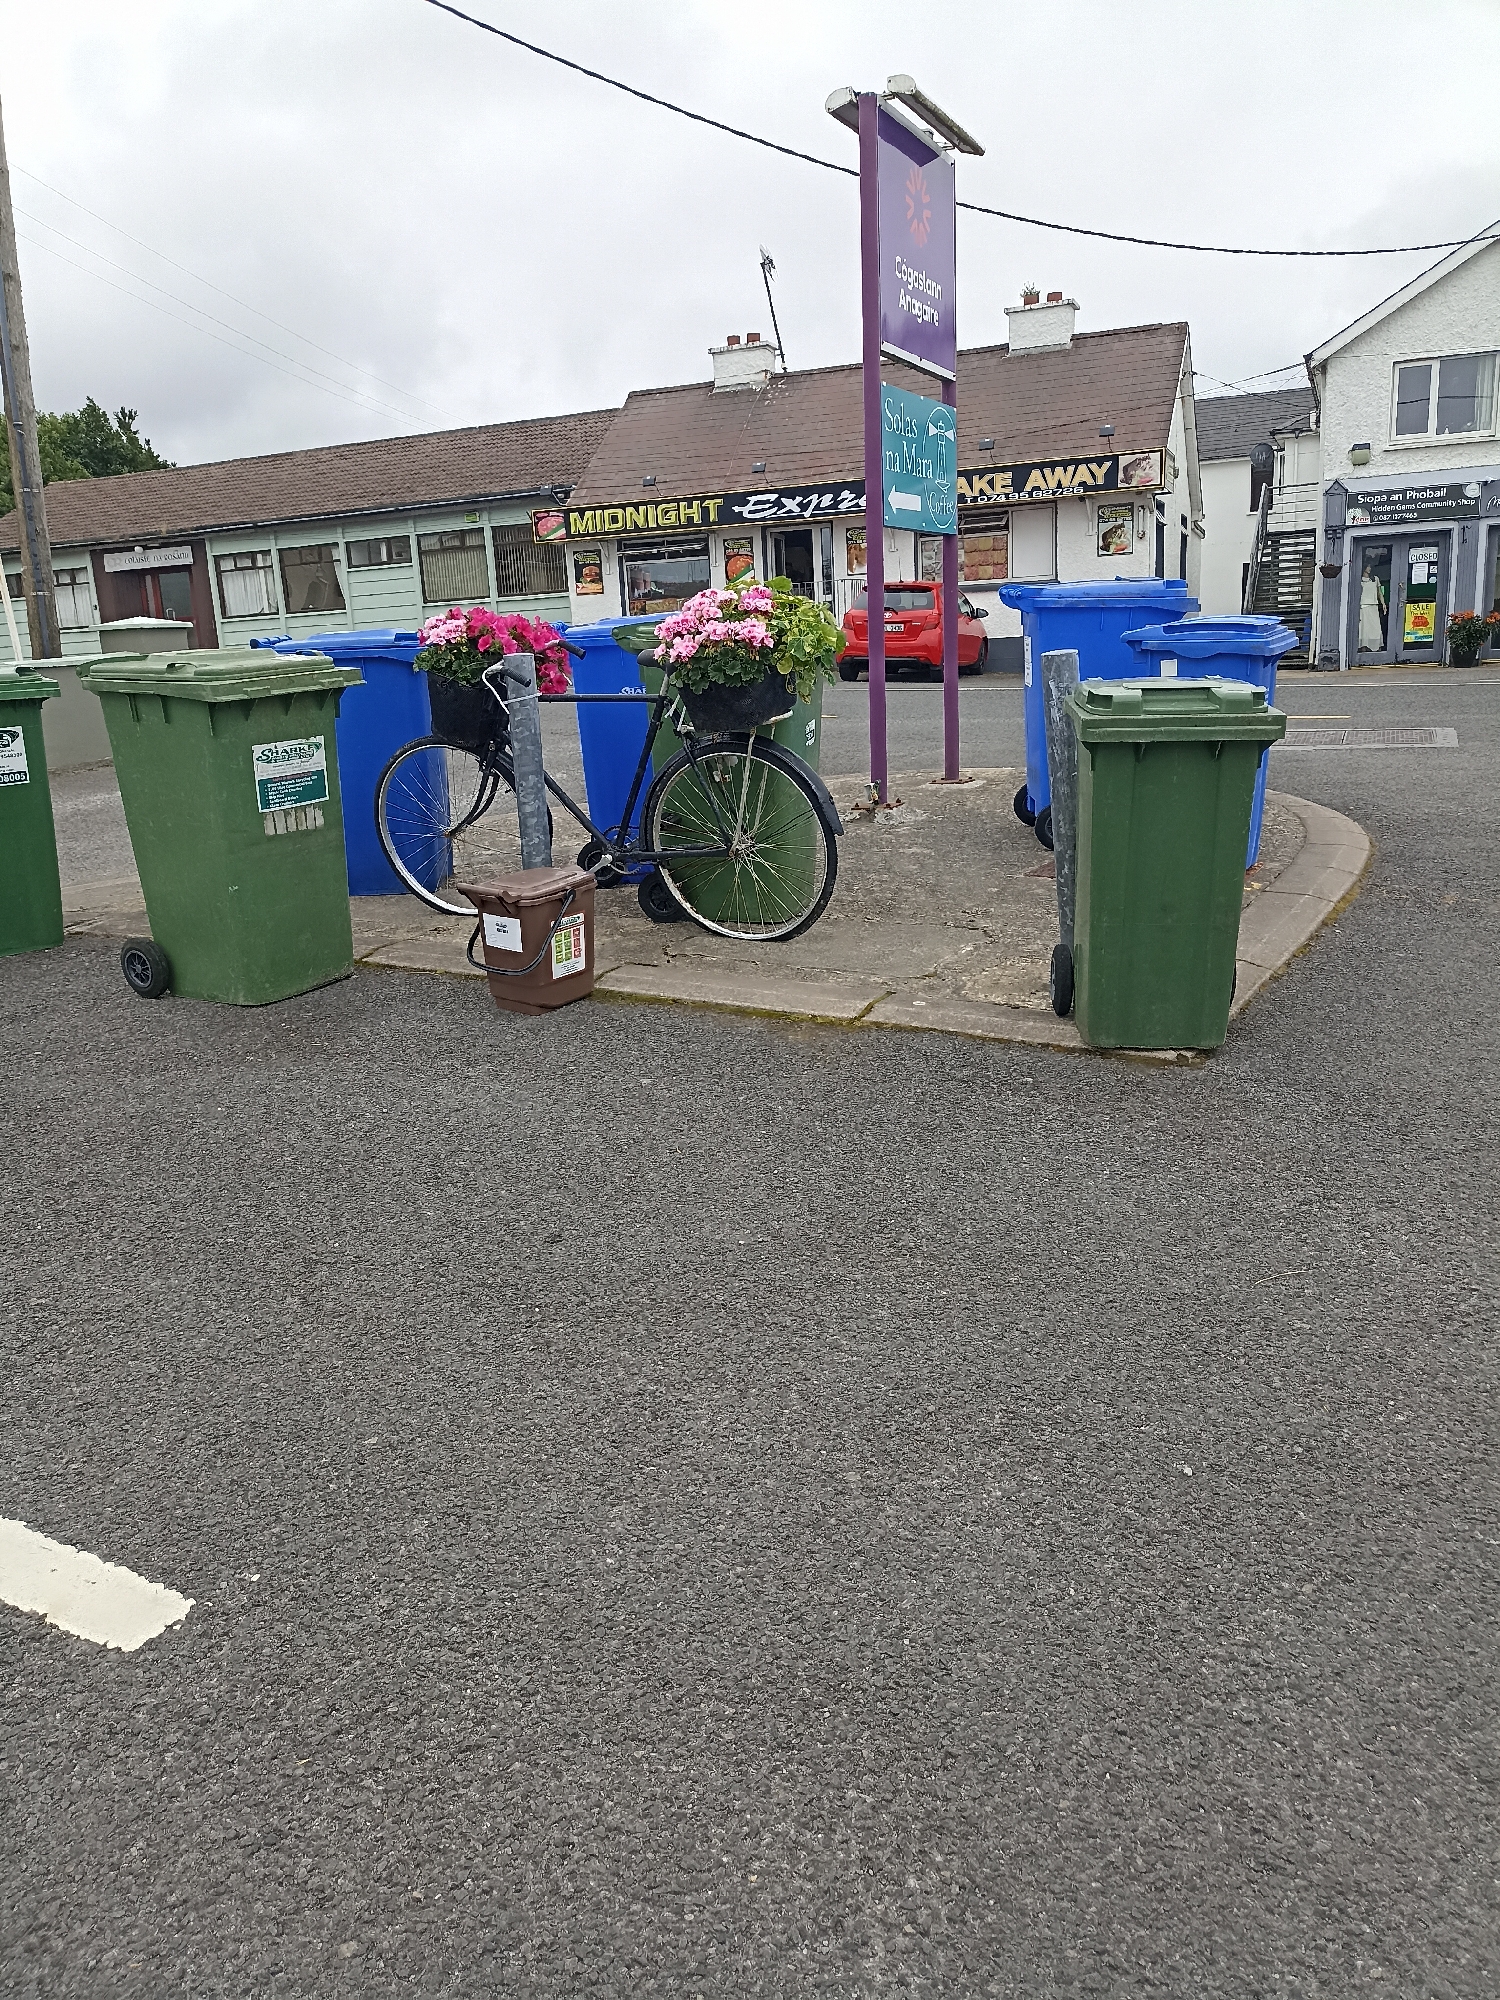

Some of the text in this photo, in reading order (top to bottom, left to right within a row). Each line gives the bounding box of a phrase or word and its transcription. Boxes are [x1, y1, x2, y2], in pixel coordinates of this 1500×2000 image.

[895, 255, 942, 301] Cógaslann
[899, 288, 939, 326] Anagaire
[884, 397, 918, 438] Solas
[886, 440, 933, 479] na Mara
[957, 461, 1112, 498] AKE AWAY
[929, 491, 954, 515] Coffee
[977, 494, 1006, 503] 074
[1009, 491, 1029, 500] 95
[1357, 487, 1447, 504] Siopa an Phobail
[1371, 498, 1476, 512] Hidden Gems Community Shop
[569, 498, 724, 535] MIDNIGHT
[1410, 552, 1438, 562] CLOSED
[1412, 603, 1430, 611] SALE
